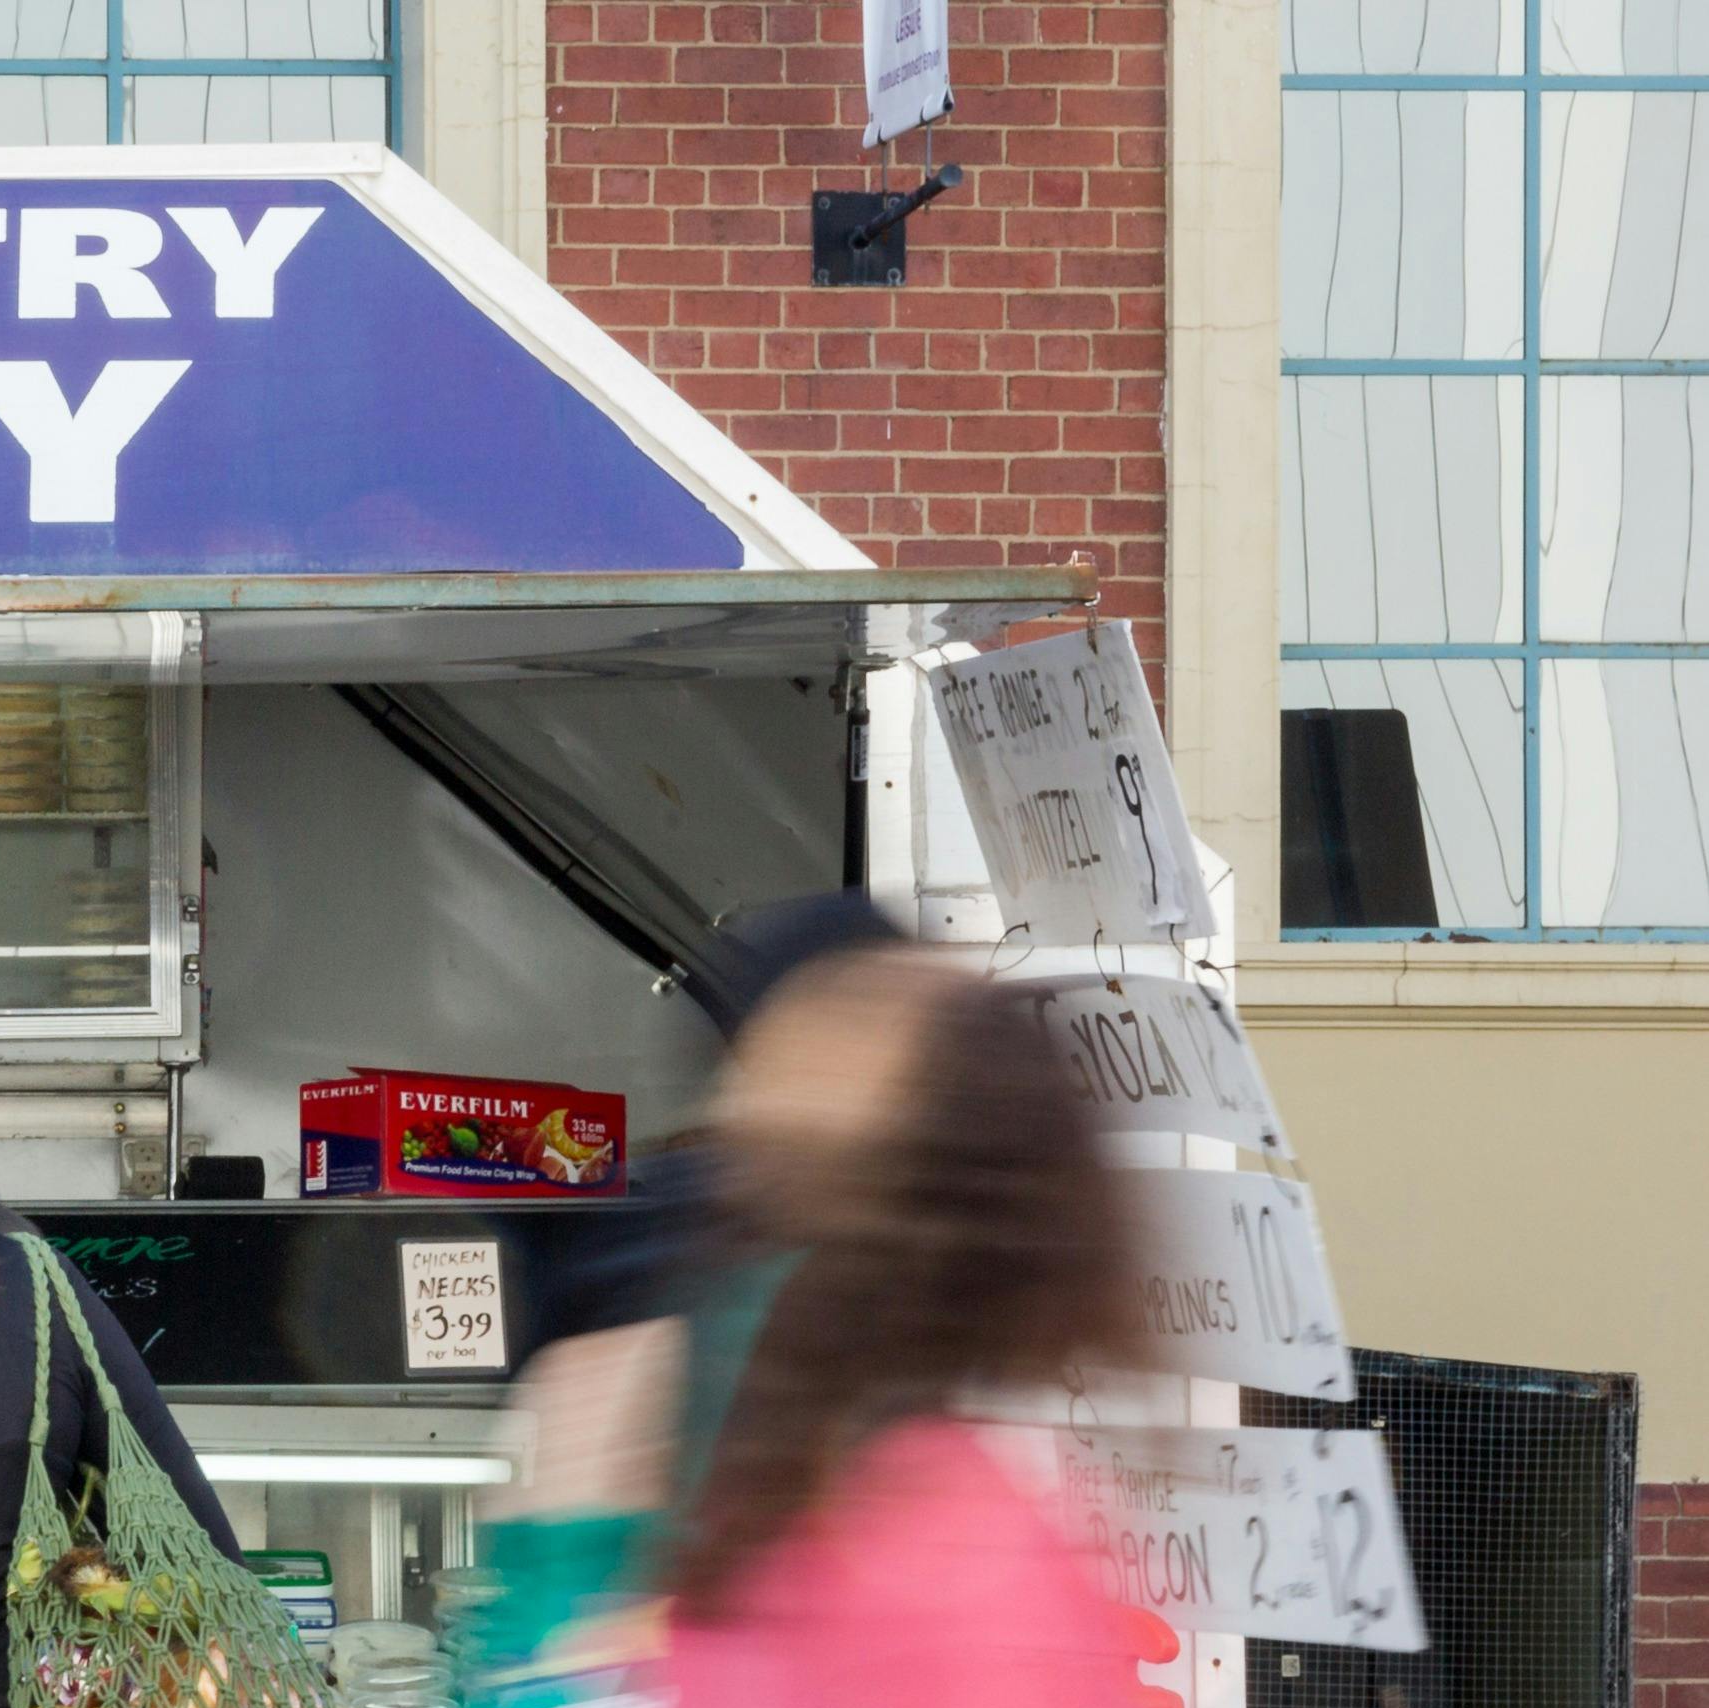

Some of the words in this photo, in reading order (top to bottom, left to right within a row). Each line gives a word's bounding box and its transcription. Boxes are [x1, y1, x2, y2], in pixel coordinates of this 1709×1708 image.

[939, 676, 995, 744] FREE
[988, 667, 1052, 738] RANGE
[302, 1084, 377, 1100] EVERFILM
[399, 1090, 530, 1118] EVERFILM
[404, 1162, 440, 1175] Premium
[441, 1164, 462, 1176] Food
[463, 1166, 493, 1179] Service
[493, 1168, 515, 1181] Cling
[515, 1170, 537, 1182] Wrap
[412, 1249, 487, 1275] CHICKEN
[417, 1274, 496, 1300] NECKS
[1135, 1274, 1238, 1338] MPLINGS
[426, 1350, 447, 1361] per
[453, 1345, 477, 1360] bag
[1111, 1450, 1180, 1513] RANGE
[1087, 1510, 1215, 1607] BACON
